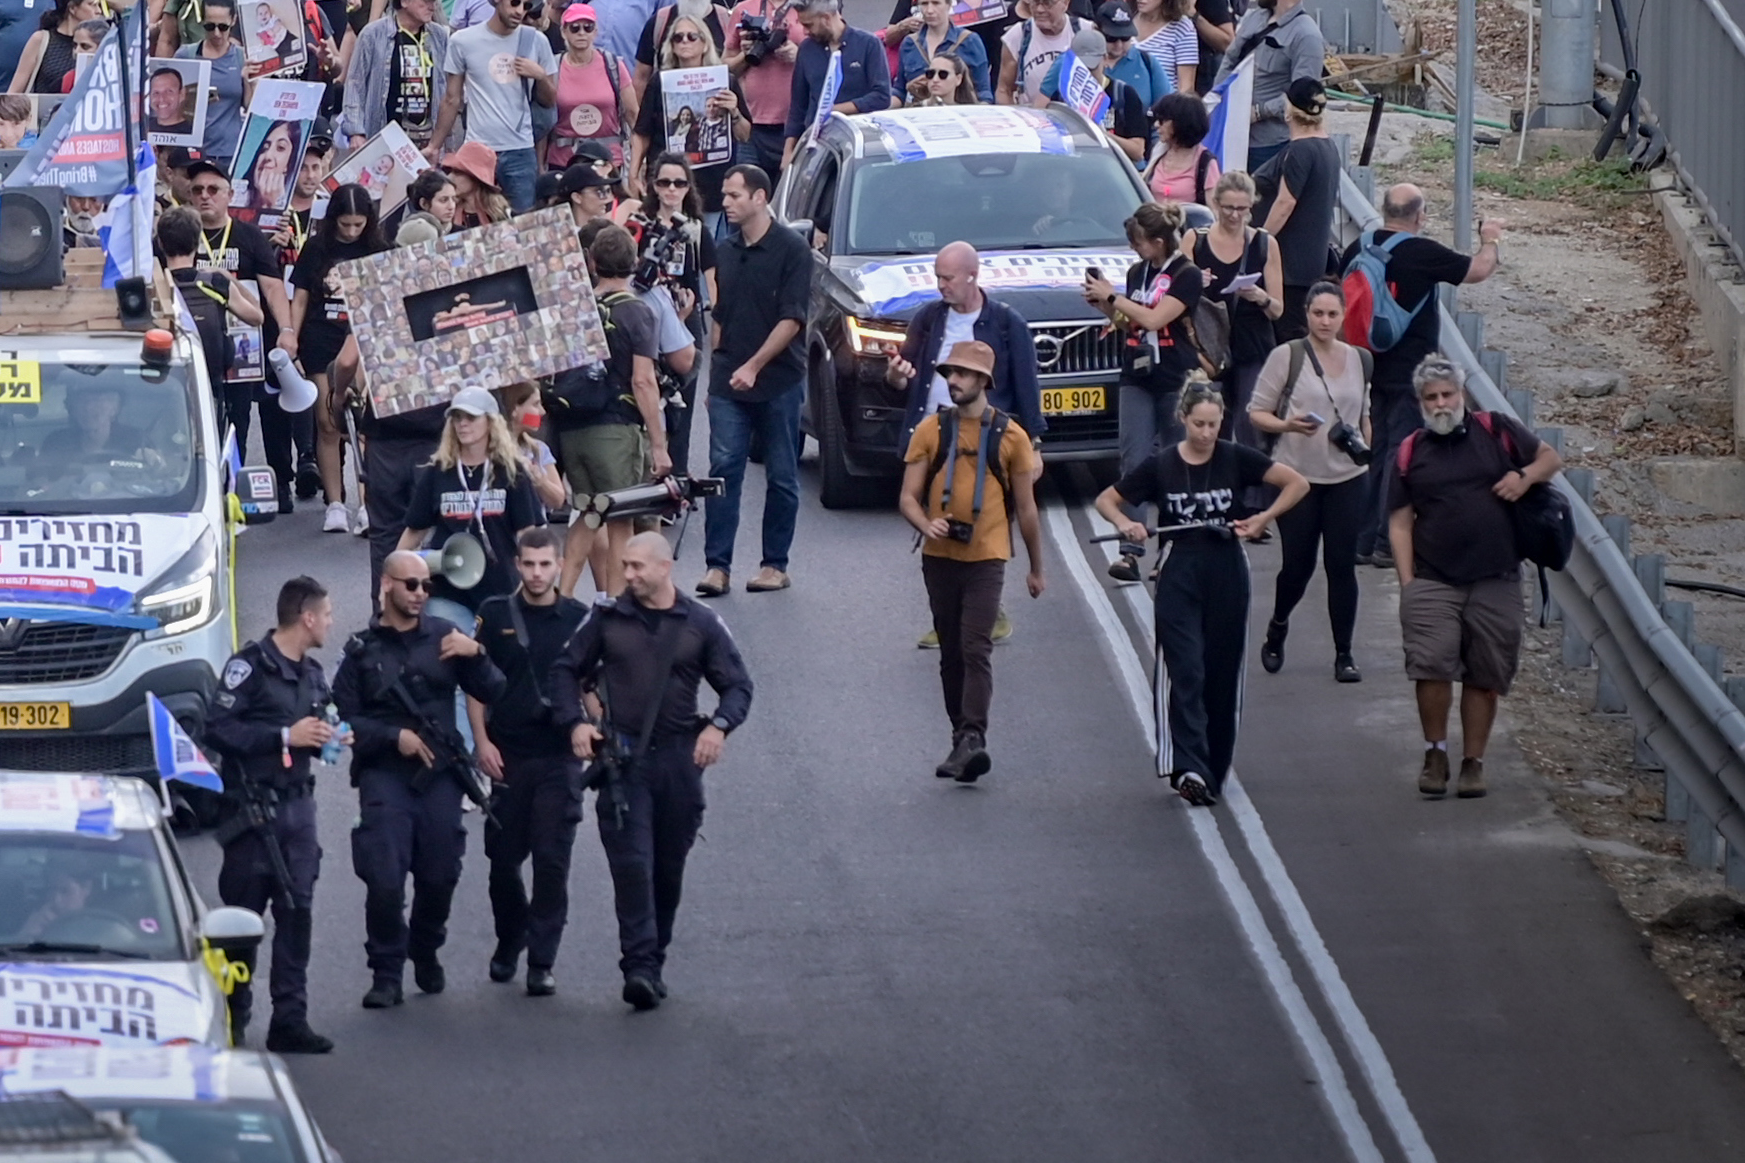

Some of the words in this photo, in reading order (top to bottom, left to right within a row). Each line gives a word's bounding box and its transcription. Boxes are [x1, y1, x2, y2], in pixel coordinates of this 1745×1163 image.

[152, 134, 177, 144] אוהד
[18, 544, 143, 577] הביתה
[13, 1000, 157, 1041] הביתה
